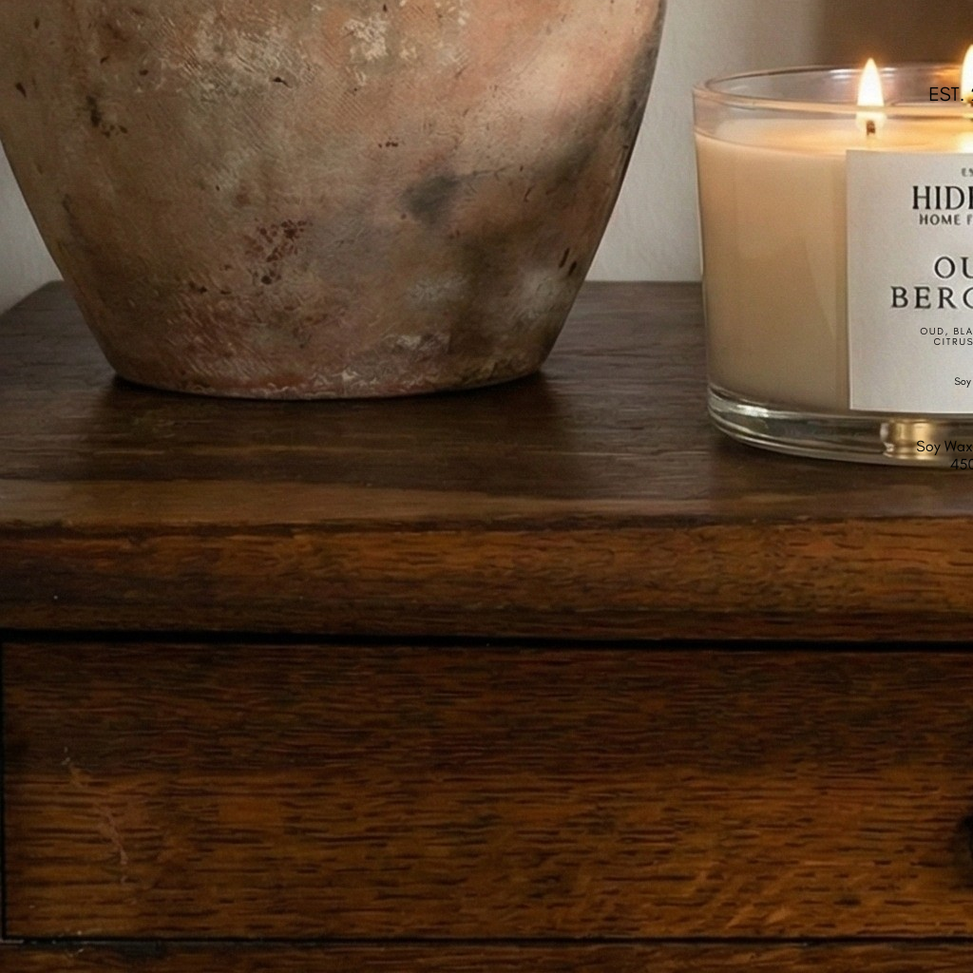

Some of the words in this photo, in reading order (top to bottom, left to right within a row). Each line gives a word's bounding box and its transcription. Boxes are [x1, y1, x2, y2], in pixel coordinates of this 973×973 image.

[919, 214, 961, 225] HOME
[920, 327, 948, 336] OUD,
[933, 338, 973, 346] CITRUS
[954, 377, 971, 388] Soy
